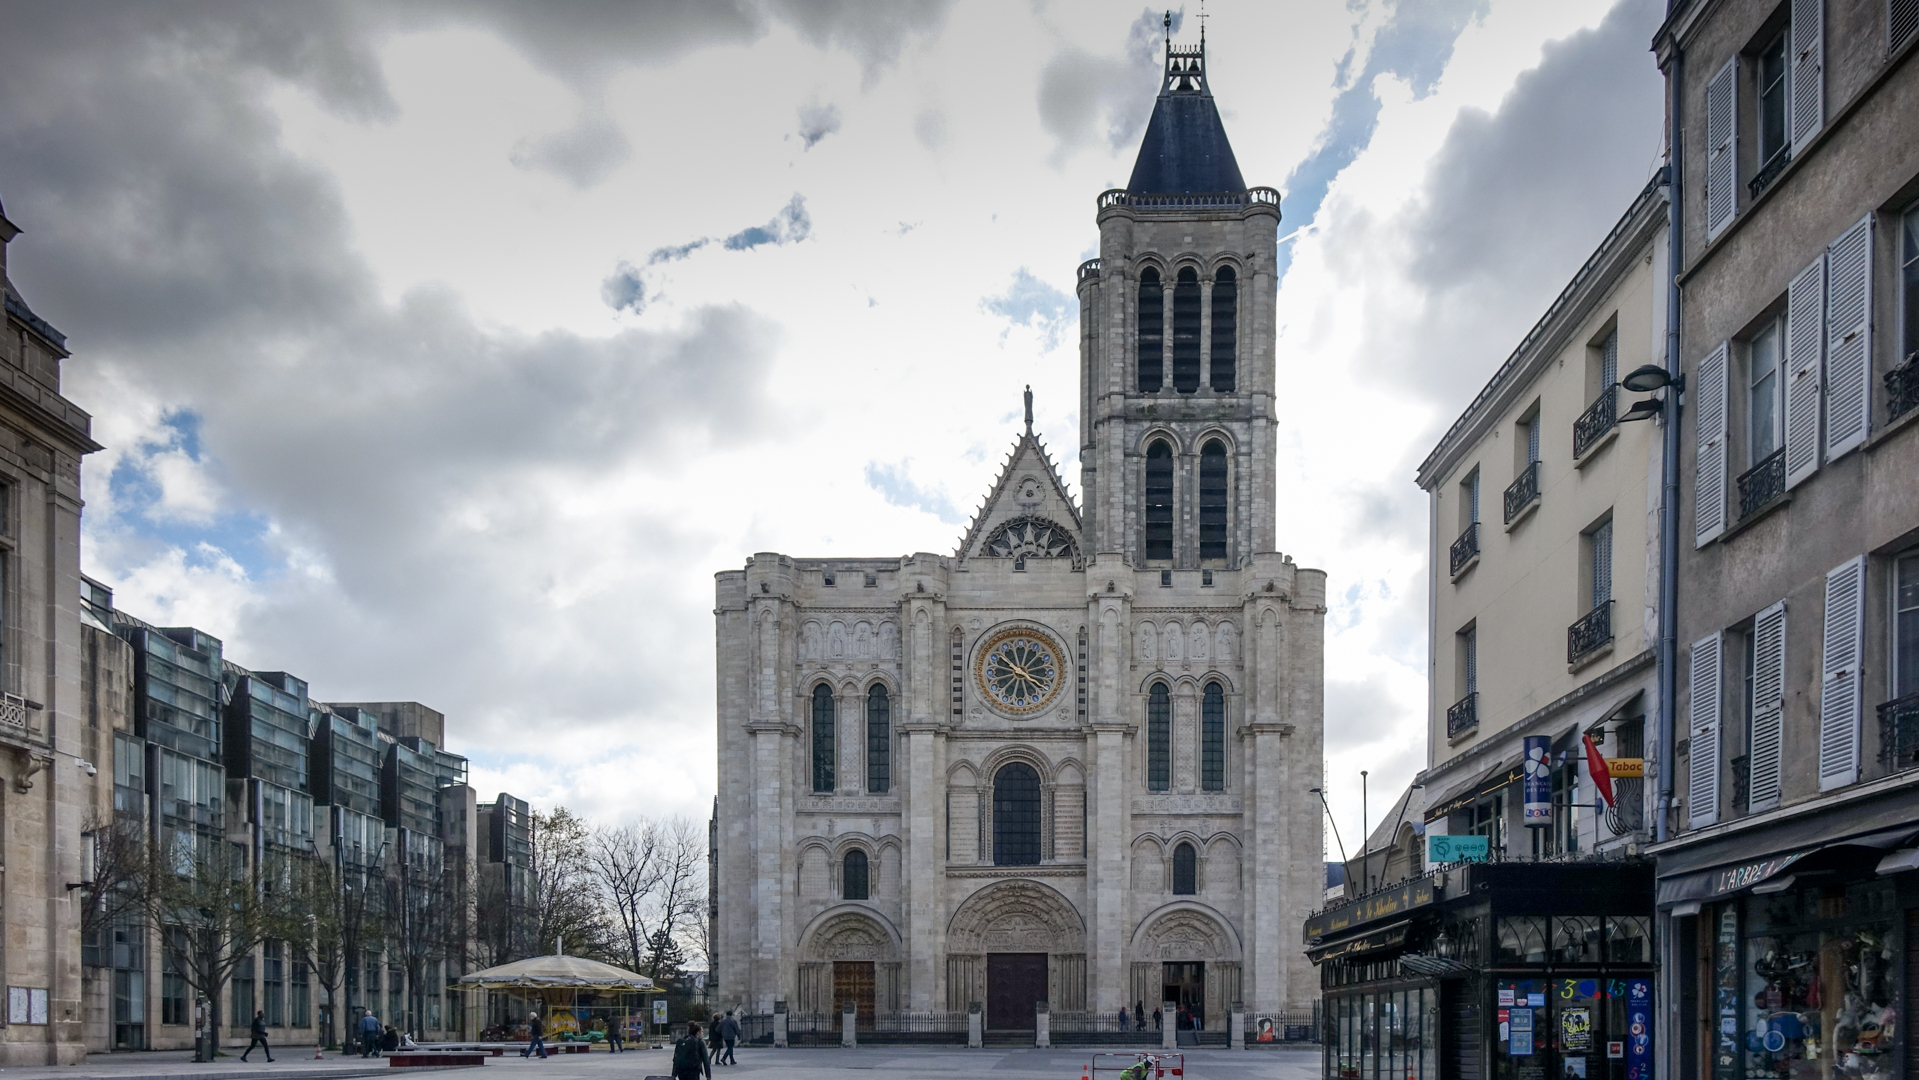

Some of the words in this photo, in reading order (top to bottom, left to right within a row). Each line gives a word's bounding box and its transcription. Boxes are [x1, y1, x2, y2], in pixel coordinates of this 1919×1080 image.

[1609, 761, 1643, 771] Tabac
[1718, 862, 1767, 892] L'ARBRE
[1561, 979, 1577, 999] 3
